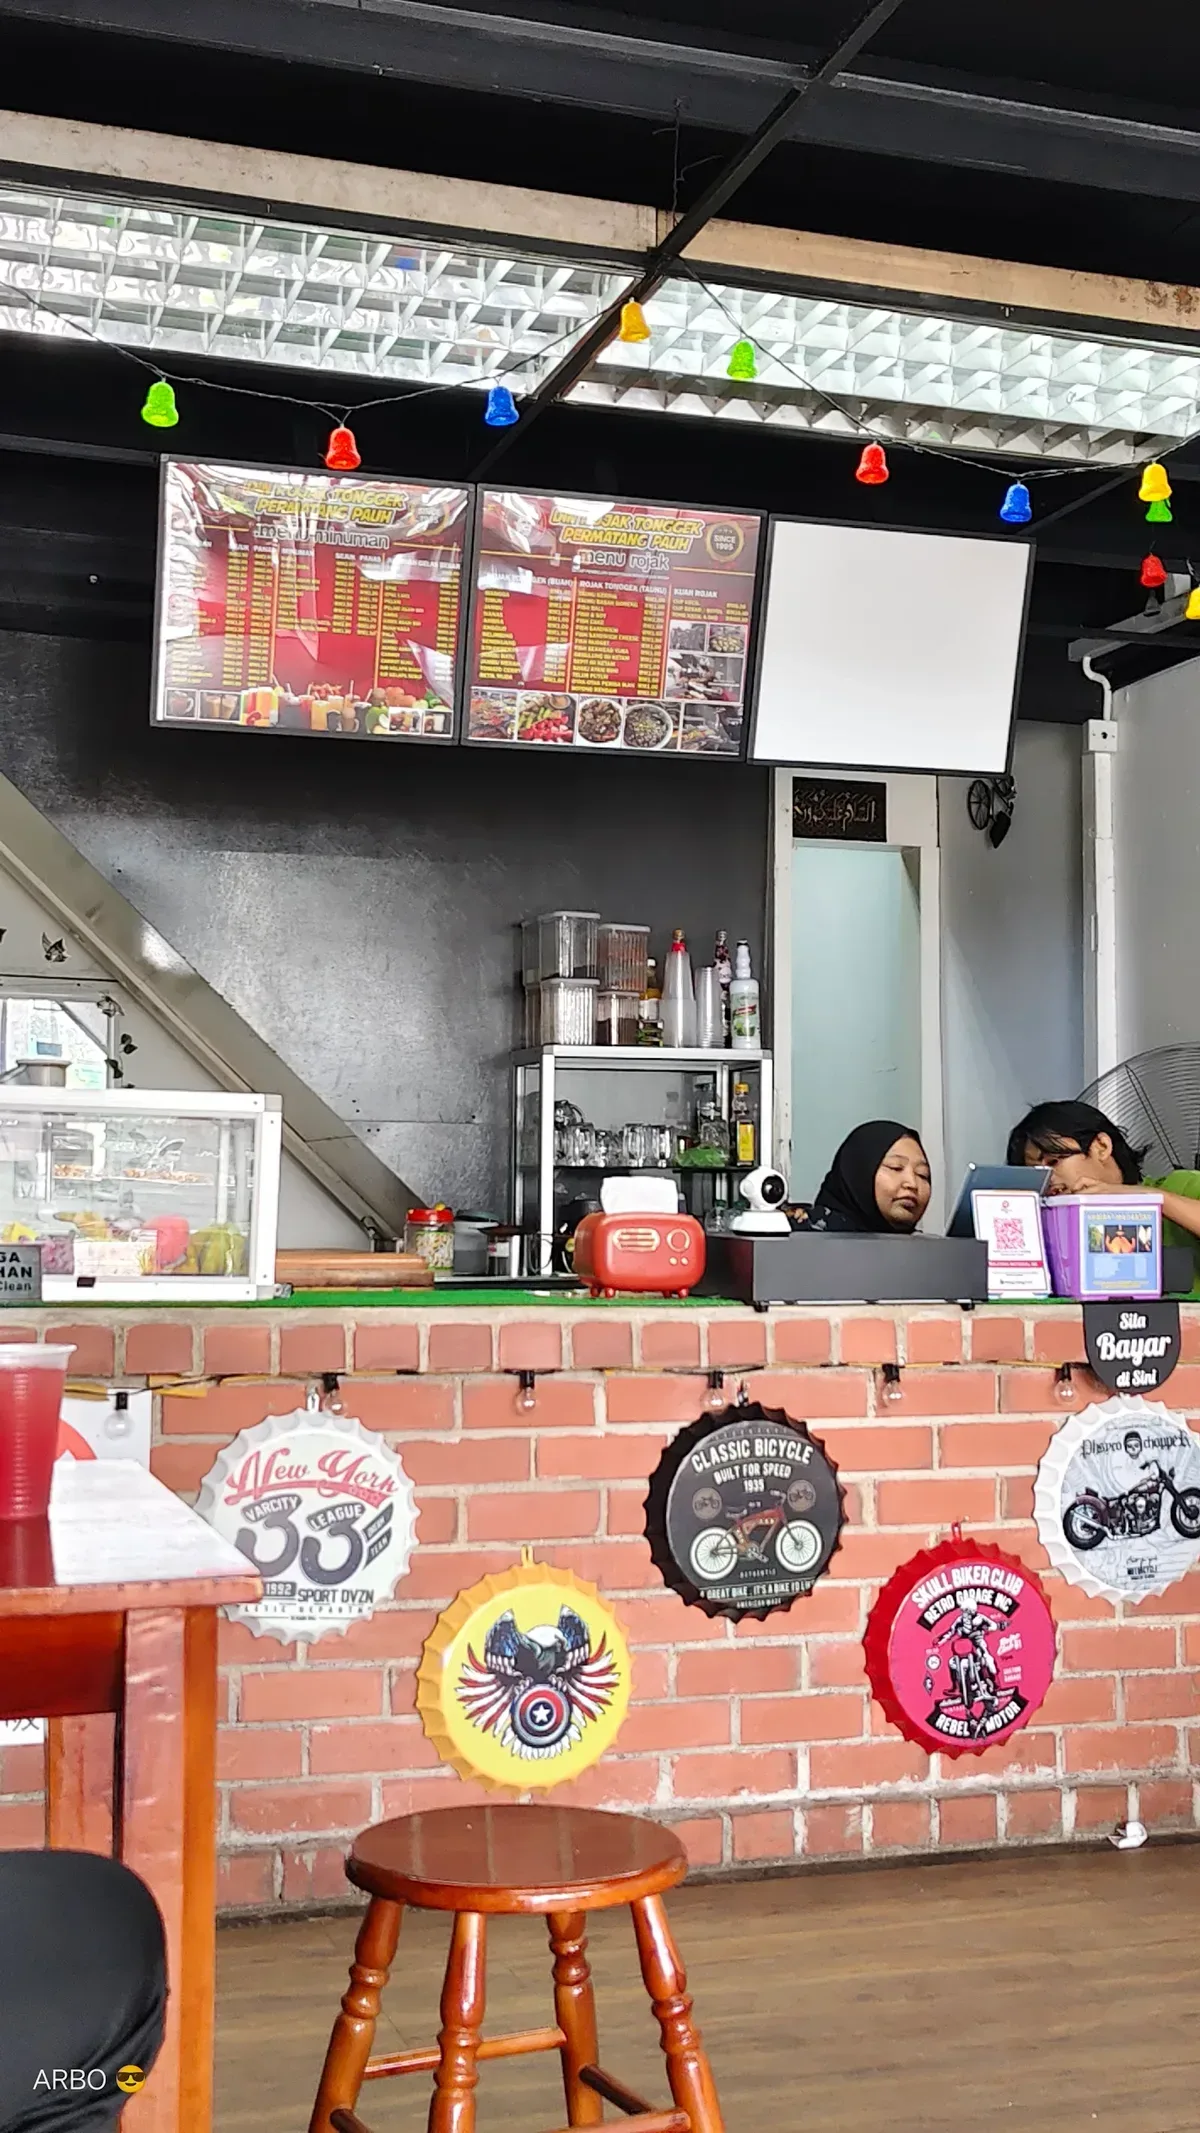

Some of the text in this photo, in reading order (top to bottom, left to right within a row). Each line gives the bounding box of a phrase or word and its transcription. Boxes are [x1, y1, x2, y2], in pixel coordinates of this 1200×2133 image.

[333, 488, 407, 509] TONGGEK
[256, 499, 394, 524] PERMATANG PAUH
[634, 515, 703, 535] TONGGEK
[315, 529, 389, 549] minuman
[563, 527, 691, 551] PERMATANG PAUH
[713, 534, 736, 544] SINCE
[580, 551, 670, 572] menu rojak
[580, 580, 603, 589] ROJAK
[1119, 1312, 1147, 1330] Sila
[1096, 1332, 1172, 1367] Bayar
[1116, 1368, 1157, 1387] di Sini
[691, 1438, 814, 1473] CLASSIC BICYCLE
[225, 1447, 399, 1500] New York
[714, 1463, 792, 1485] BUILT FOR SPEED
[245, 1495, 300, 1522] VARCITY
[309, 1503, 364, 1531] LEAGUE
[265, 1582, 375, 1604] 1992 SPORT DVZN
[706, 1587, 730, 1599] GREAT
[911, 1565, 1025, 1609] SKULL BIKER CLUB
[923, 1588, 1013, 1625] RETRO GARAGE INC
[935, 1703, 1022, 1738] REBEL MOTOR
